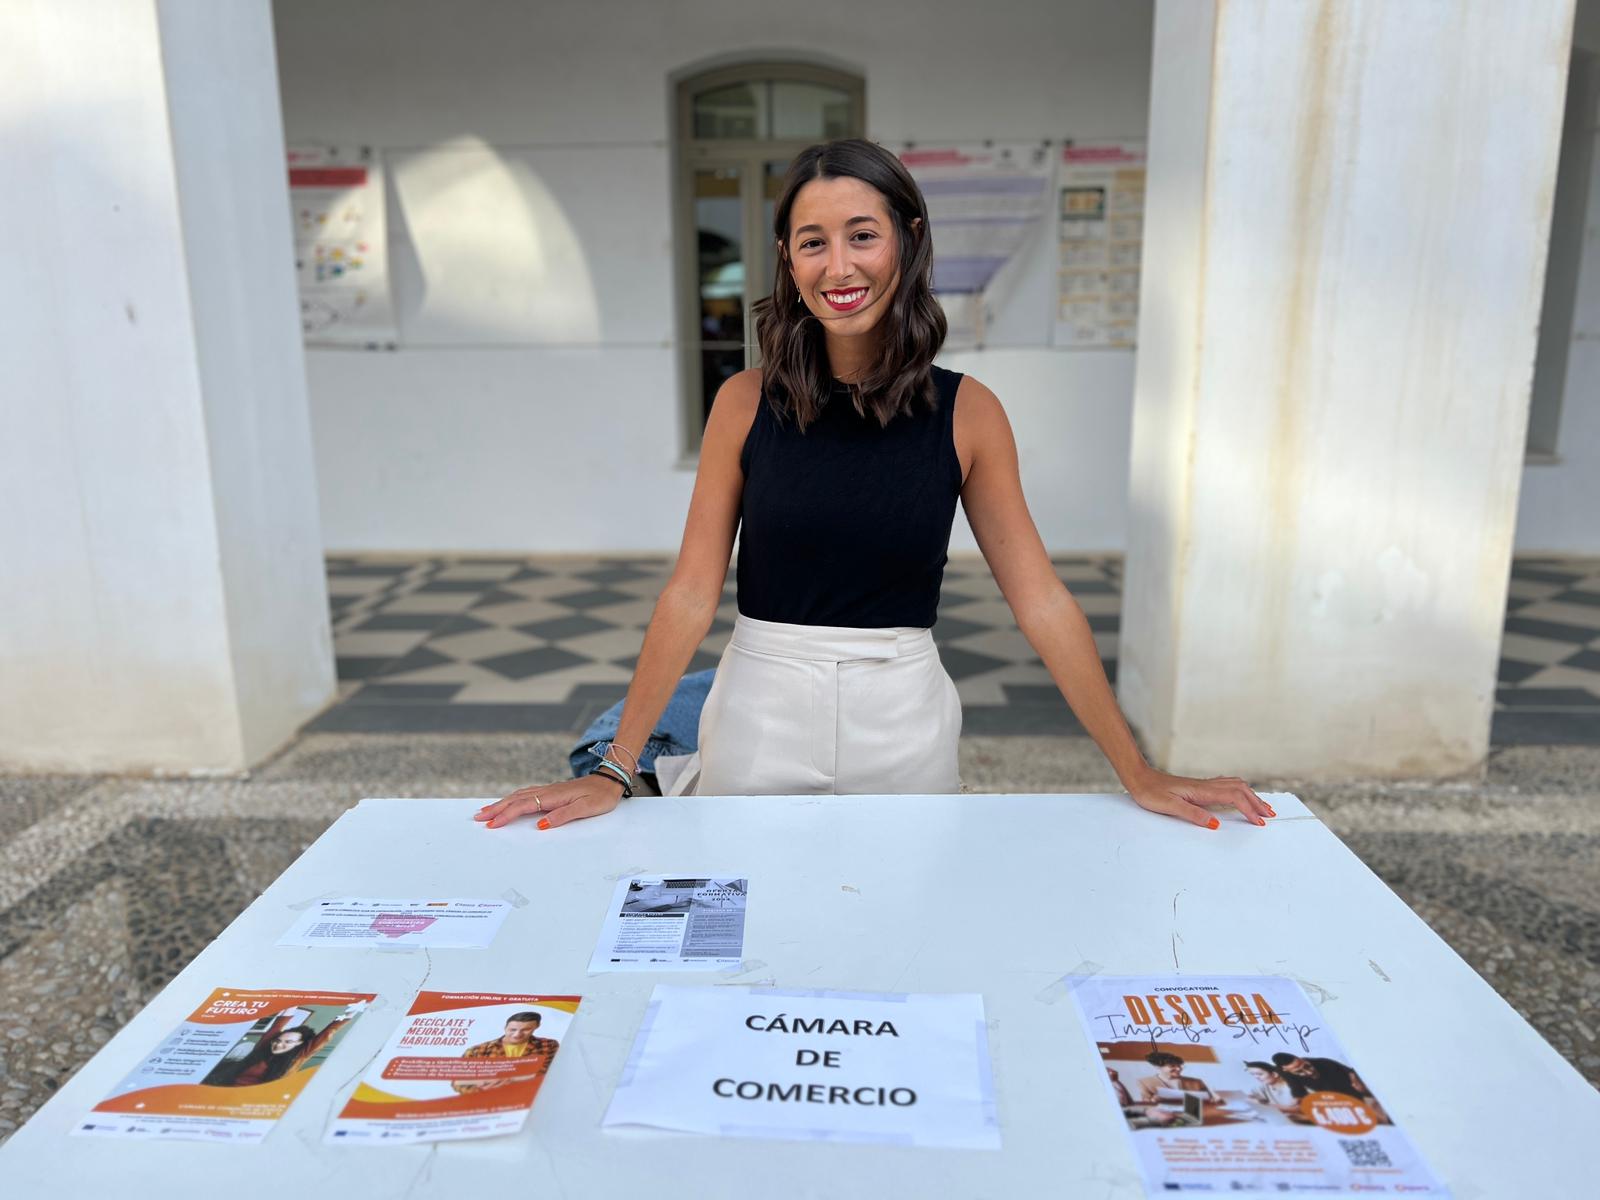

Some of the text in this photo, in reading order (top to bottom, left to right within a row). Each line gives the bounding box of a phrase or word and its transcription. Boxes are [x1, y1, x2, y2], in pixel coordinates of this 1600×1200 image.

[213, 1000, 247, 1008] CREA
[205, 1007, 258, 1015] FUTURO
[1123, 994, 1283, 1025] DESPEGA
[412, 1018, 475, 1027] RECÍCLATE Y
[745, 1013, 899, 1037] CÁMARA
[406, 1027, 468, 1036] MEJORA TUS
[399, 1036, 468, 1046] HABILIDADES
[796, 1049, 841, 1068] DE
[713, 1078, 917, 1106] COMERCIO
